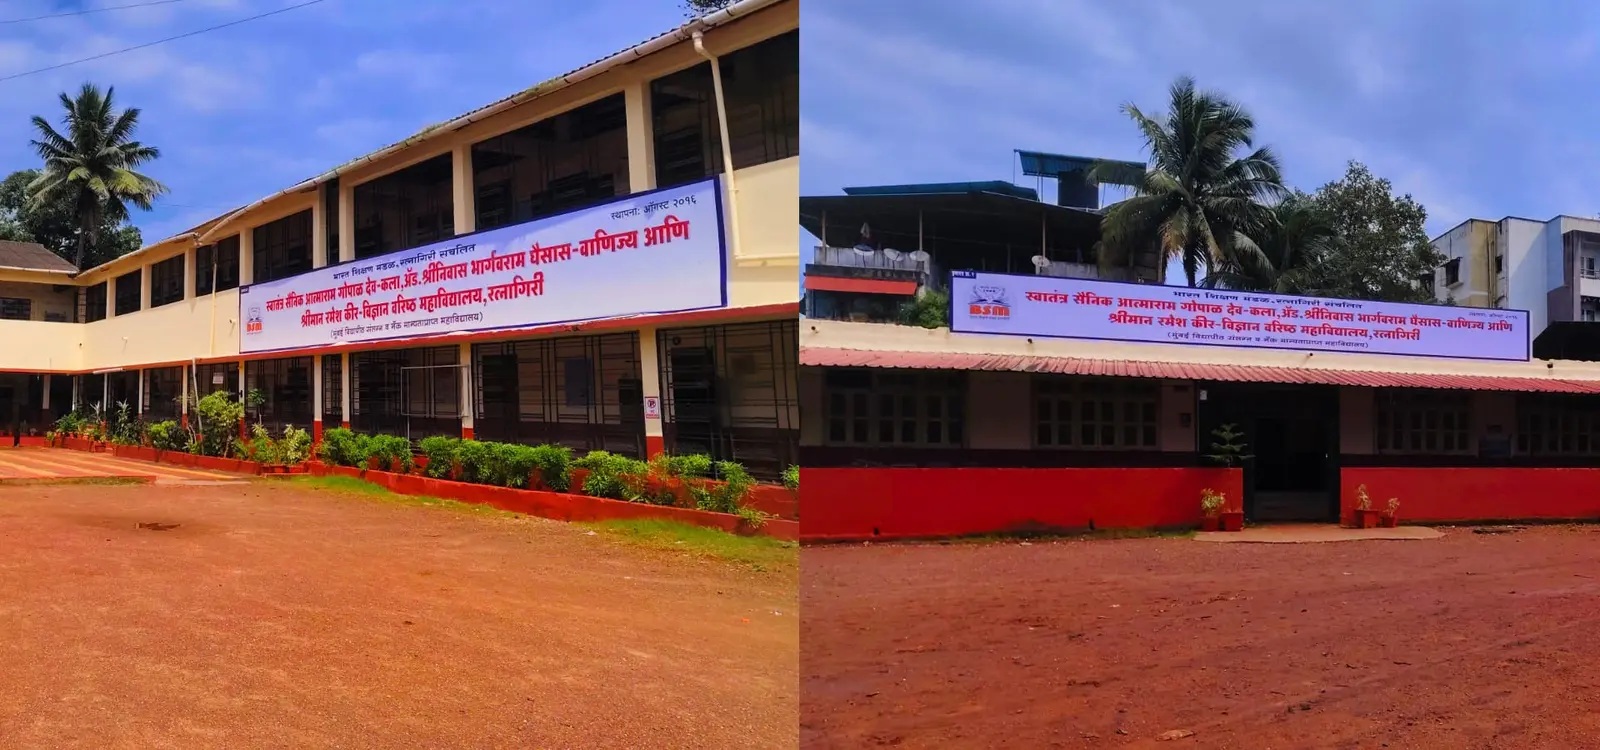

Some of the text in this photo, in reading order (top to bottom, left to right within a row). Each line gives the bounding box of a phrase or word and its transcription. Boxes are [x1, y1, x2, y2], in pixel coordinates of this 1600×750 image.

[611, 195, 696, 220] स्थापना: ऑगस्ट २०१६
[266, 294, 284, 312] स्वातंत्र
[285, 291, 304, 308] सैनिक
[305, 288, 336, 306] आत्माराम
[338, 282, 363, 299] गोपाळ
[471, 250, 526, 275] भार्गवराम
[644, 215, 689, 247] आणि
[333, 270, 349, 280] भारत
[352, 265, 373, 277] शिक्षण
[440, 243, 476, 257] संचलित
[1205, 291, 1238, 301] शिक्षण
[301, 310, 323, 327] श्रीमान
[325, 307, 342, 323] रमेश
[391, 294, 416, 313] वरिष्ठ
[440, 312, 483, 325] महाविद्यालय)
[969, 304, 1010, 317] BSM
[1025, 290, 1068, 304] स्वातंत्र
[1073, 292, 1113, 306] सैनिक
[1117, 297, 1176, 311] आत्माराम
[1180, 300, 1223, 314] गोपाळ
[1358, 311, 1406, 325] भार्गवराम
[1488, 319, 1512, 332] आणि
[1109, 310, 1153, 325] श्रीमान
[1158, 314, 1187, 328] रमेश
[1264, 320, 1297, 333] वरिष्ठ
